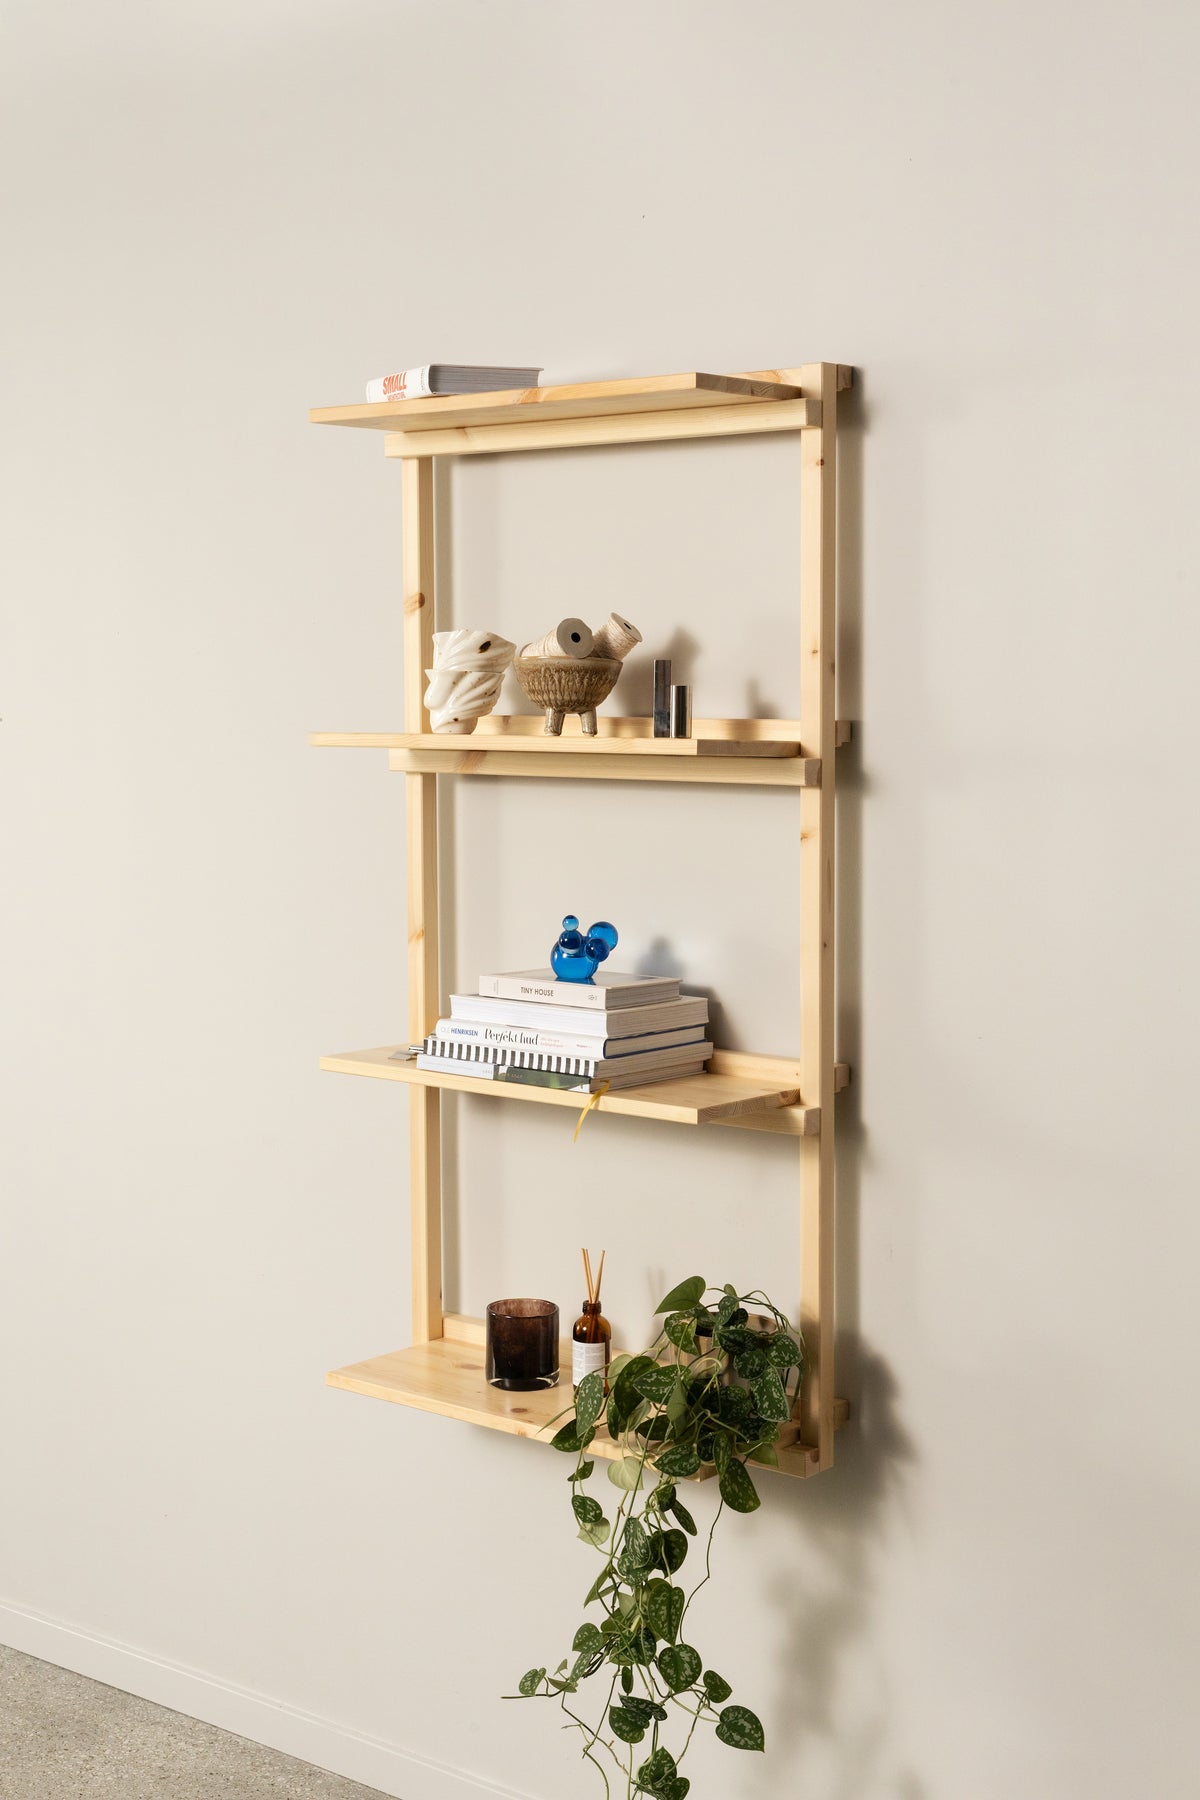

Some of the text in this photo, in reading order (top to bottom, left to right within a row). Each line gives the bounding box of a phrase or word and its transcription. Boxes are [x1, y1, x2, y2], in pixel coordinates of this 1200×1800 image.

[383, 372, 407, 395] SMALL
[520, 986, 554, 997] TINY HOUSE
[450, 1027, 479, 1037] HENRIKSEN
[520, 1032, 539, 1045] hud
